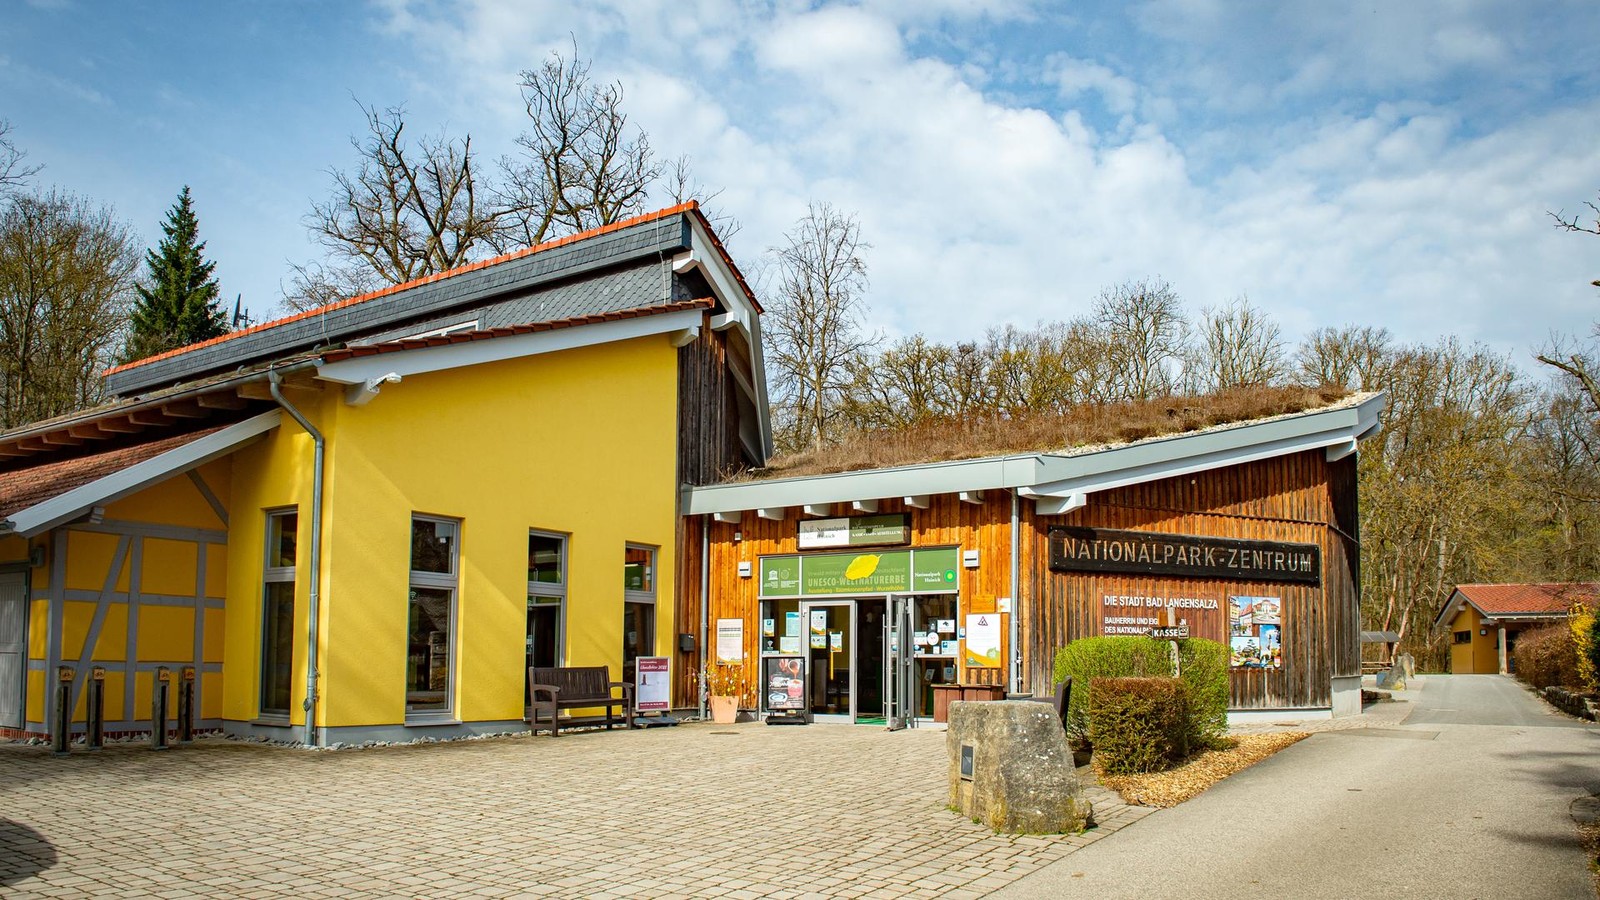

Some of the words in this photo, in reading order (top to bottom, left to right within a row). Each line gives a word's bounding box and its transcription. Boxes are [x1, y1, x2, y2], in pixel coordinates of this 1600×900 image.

[1104, 595, 1118, 606] DIE
[1120, 596, 1145, 607] STADT
[1146, 597, 1162, 607] BAD
[1164, 598, 1219, 609] LANGENSALZA
[1104, 616, 1135, 625] BAUHERRIN
[1137, 617, 1148, 625] UND
[1105, 626, 1117, 634] DES
[1153, 629, 1178, 637] KASSE
